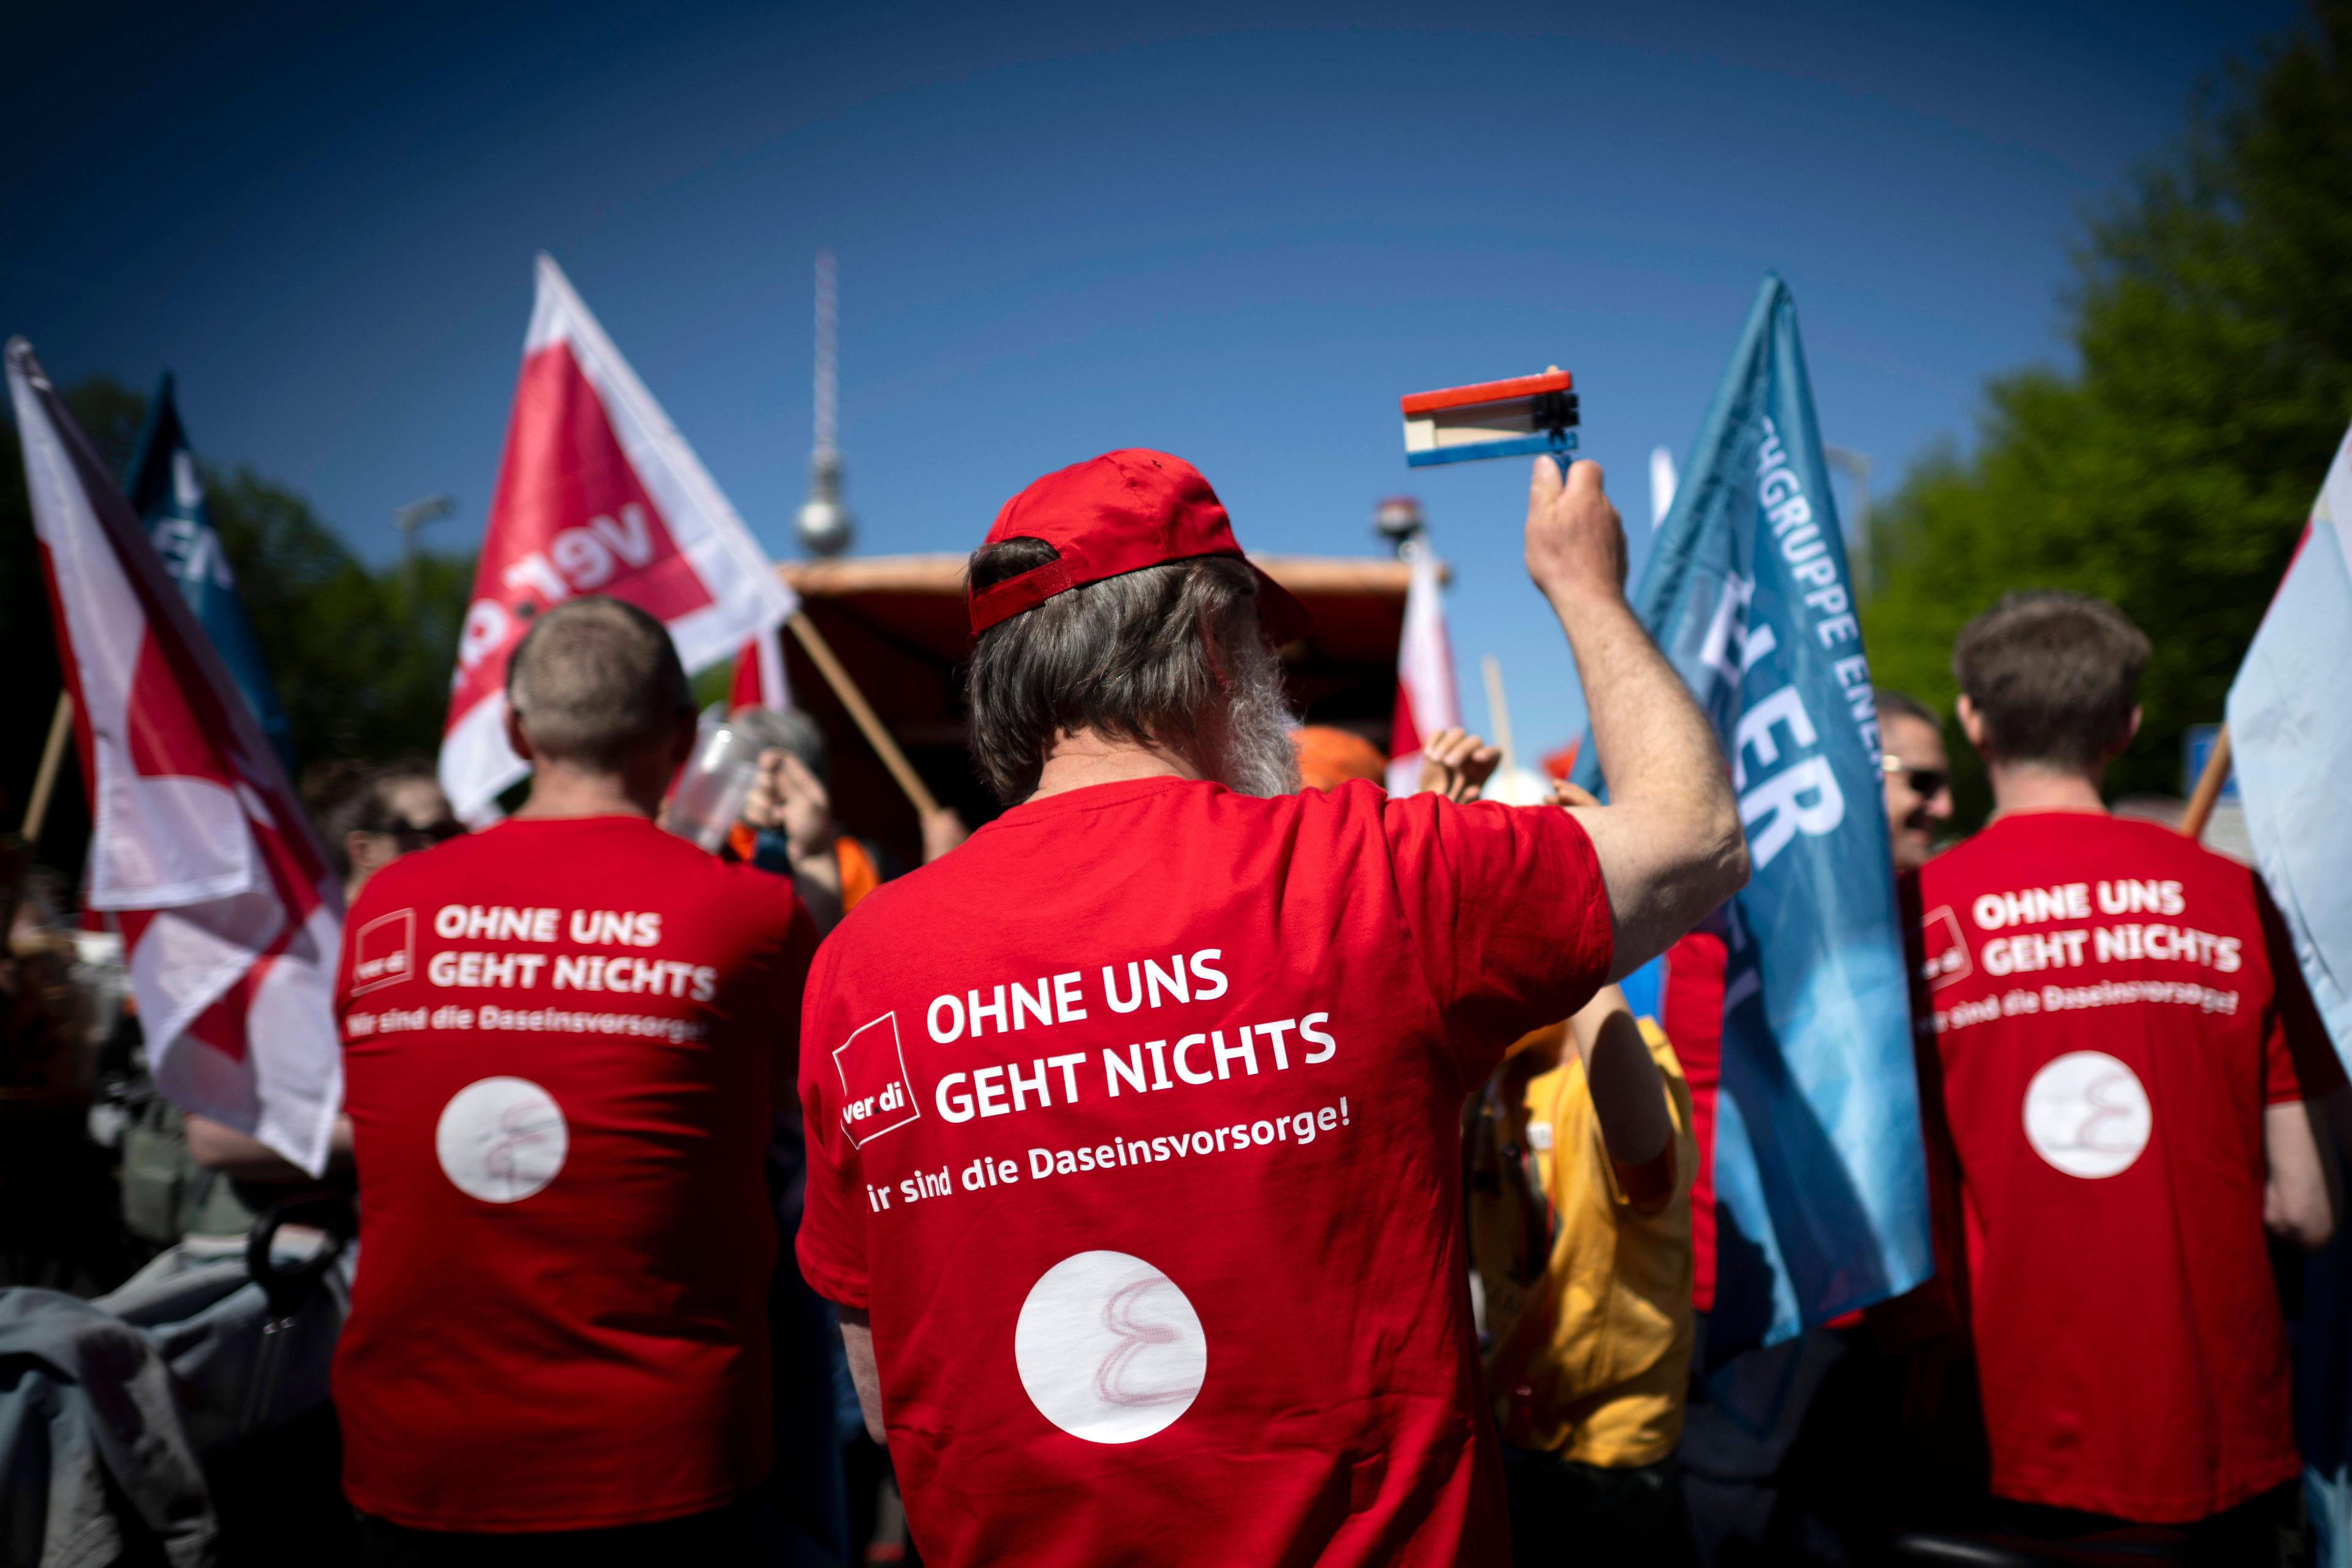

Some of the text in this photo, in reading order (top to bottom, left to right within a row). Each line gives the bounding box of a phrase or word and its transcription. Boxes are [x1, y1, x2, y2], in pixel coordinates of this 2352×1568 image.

[434, 903, 662, 948] OHNE UNS
[1972, 879, 2185, 930] OHNE UNS
[1981, 922, 2242, 976] GEHT NICHTS
[427, 950, 717, 1002] GEHT NICHTS
[927, 948, 1228, 1044] OHNE UNS
[377, 1006, 428, 1033] sind
[430, 1005, 475, 1030] die
[1949, 994, 2002, 1030] sind
[2001, 988, 2041, 1017] die
[935, 1012, 1336, 1123] GEHT NICHTS
[843, 1081, 905, 1124] ver.di
[867, 1096, 1351, 1213] ir sind die Daseinsvorsorge!
